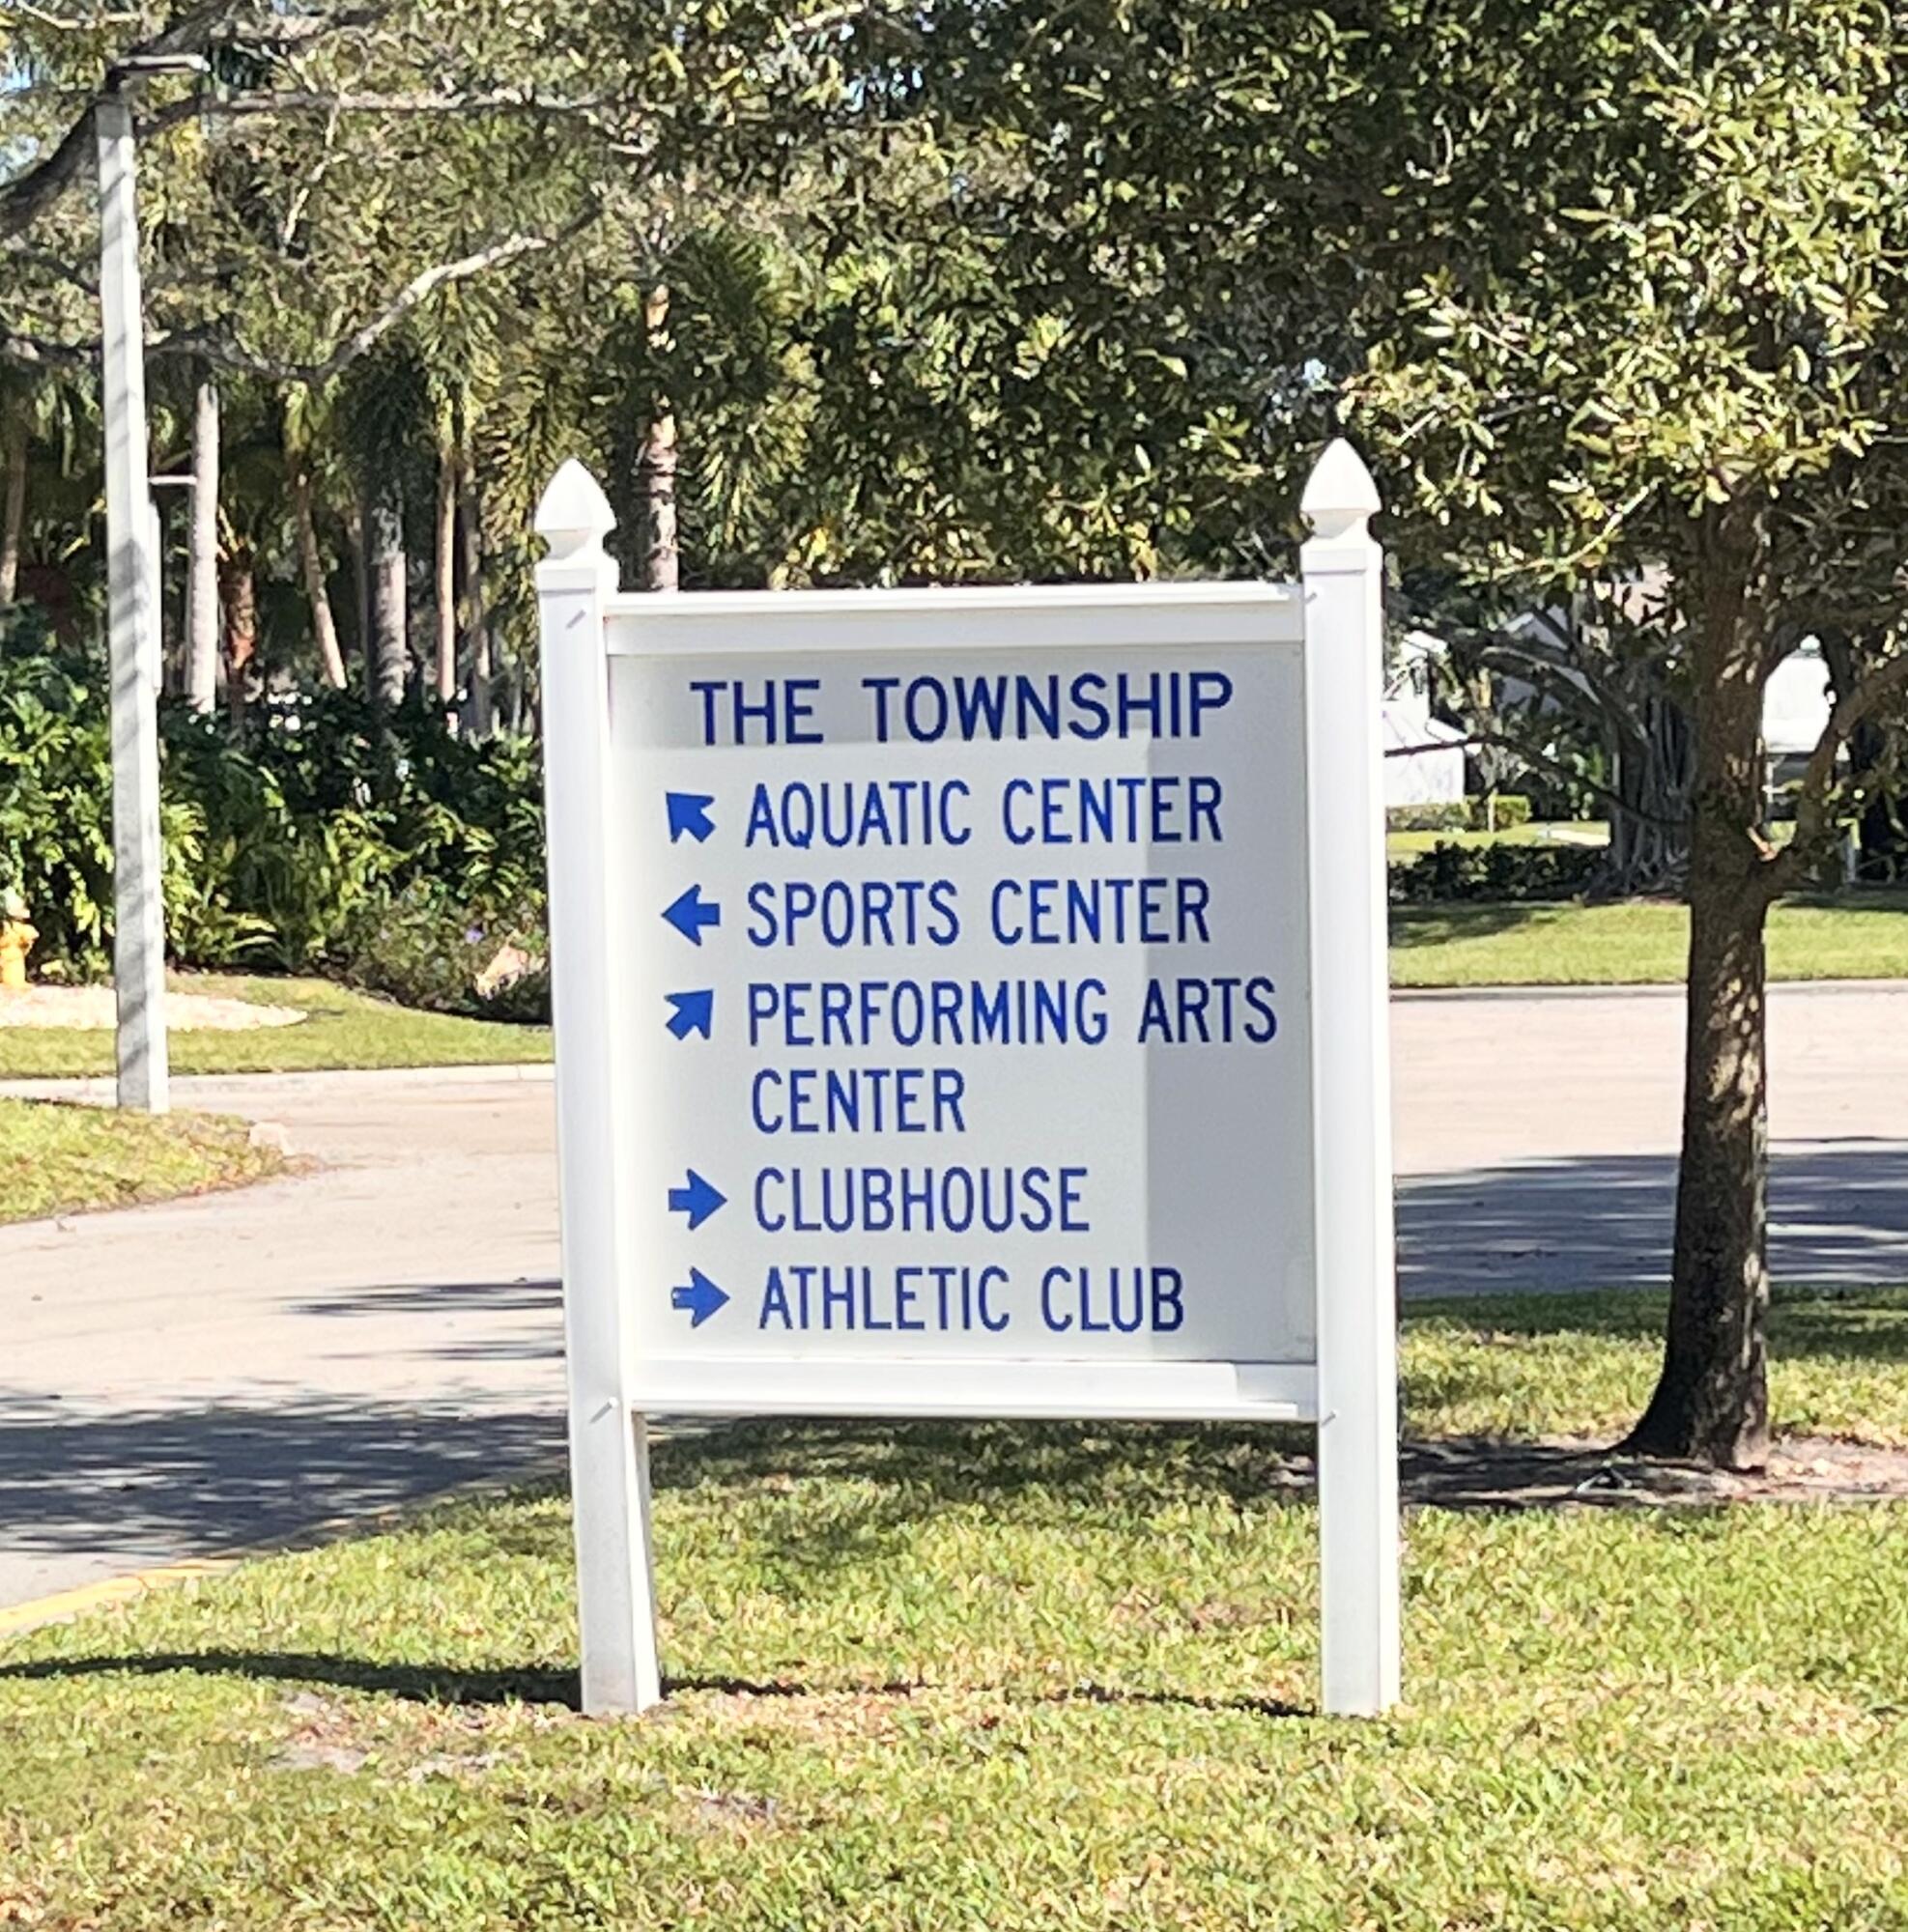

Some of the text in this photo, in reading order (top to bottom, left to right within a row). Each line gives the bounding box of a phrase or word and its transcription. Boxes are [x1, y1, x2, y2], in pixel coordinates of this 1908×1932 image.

[690, 670, 1234, 745] THE TOWNSHIP
[746, 776, 1223, 850] AQUATIC CENTER
[747, 877, 1210, 949] SPORTS CENTER
[748, 977, 1278, 1047] PERFORMING ARTS
[752, 1067, 966, 1134] CENTER
[755, 1167, 1090, 1234] CLUBHOUSE
[758, 1265, 1185, 1334] ATHLETIC CLUB
